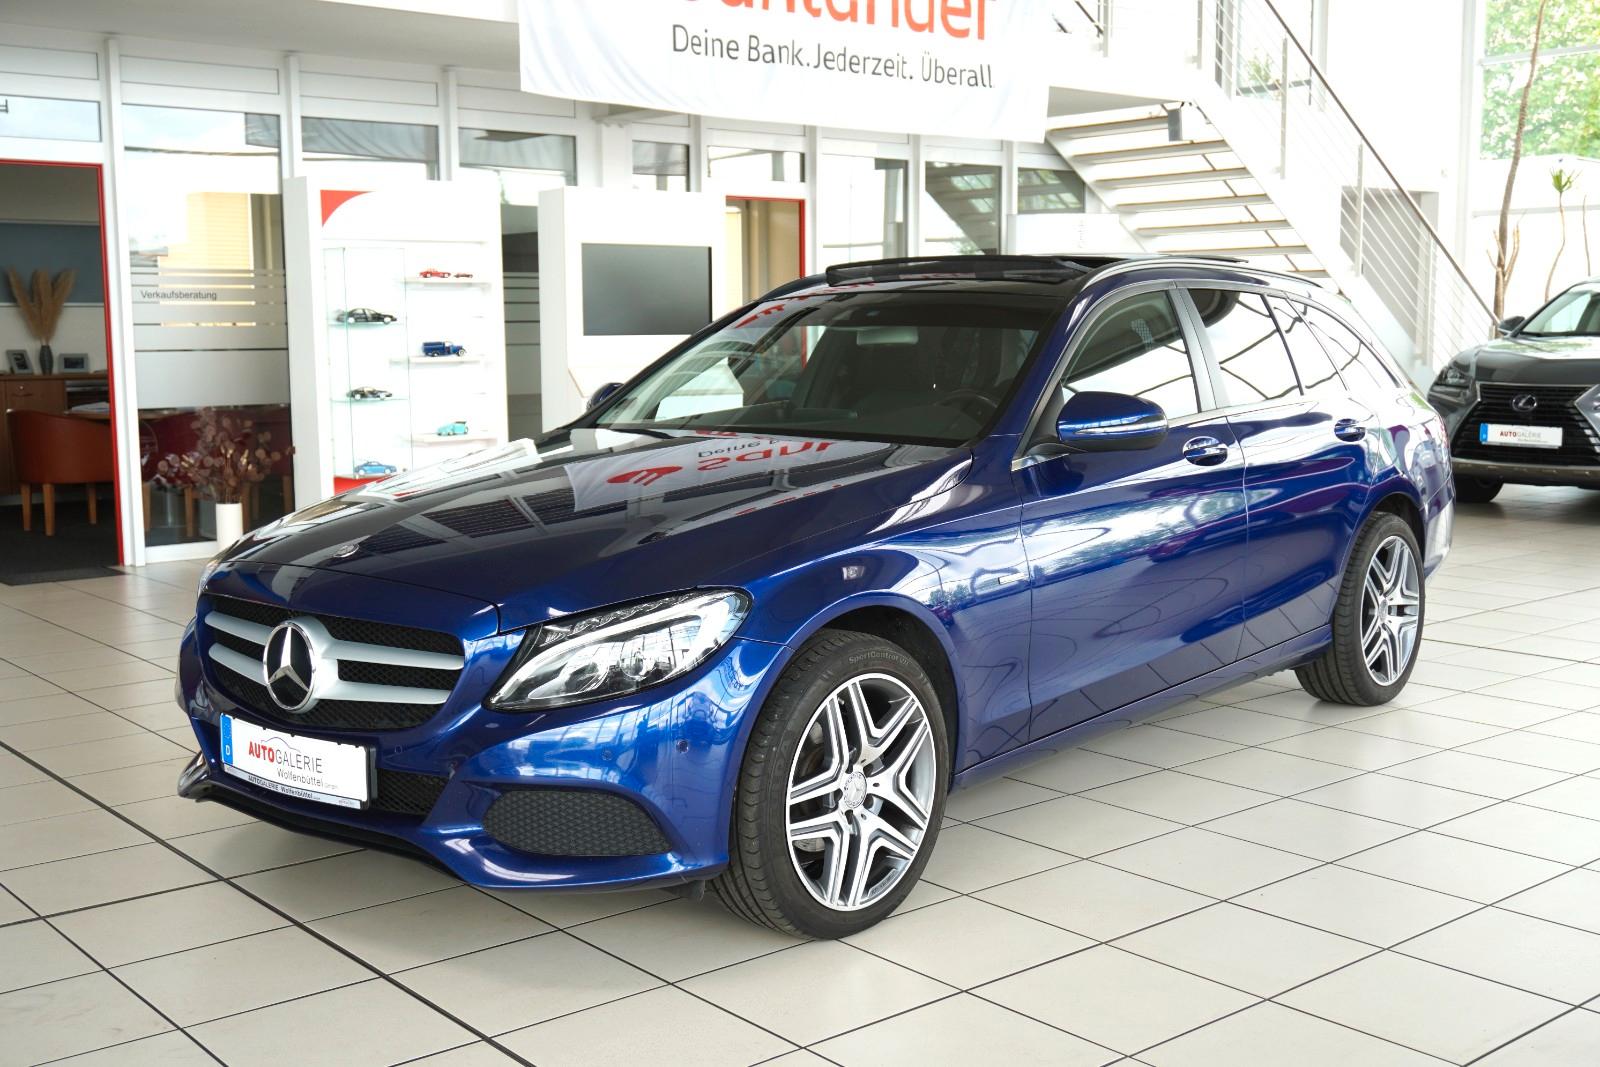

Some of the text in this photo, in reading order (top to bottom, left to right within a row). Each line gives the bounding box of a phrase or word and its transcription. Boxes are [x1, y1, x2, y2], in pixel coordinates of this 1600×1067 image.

[672, 24, 739, 60] Deine
[140, 290, 217, 301] Verkaufsberatung
[225, 744, 231, 756] D
[248, 740, 323, 774] AUTOGALERIE
[277, 767, 324, 788] Wolfenbüttel
